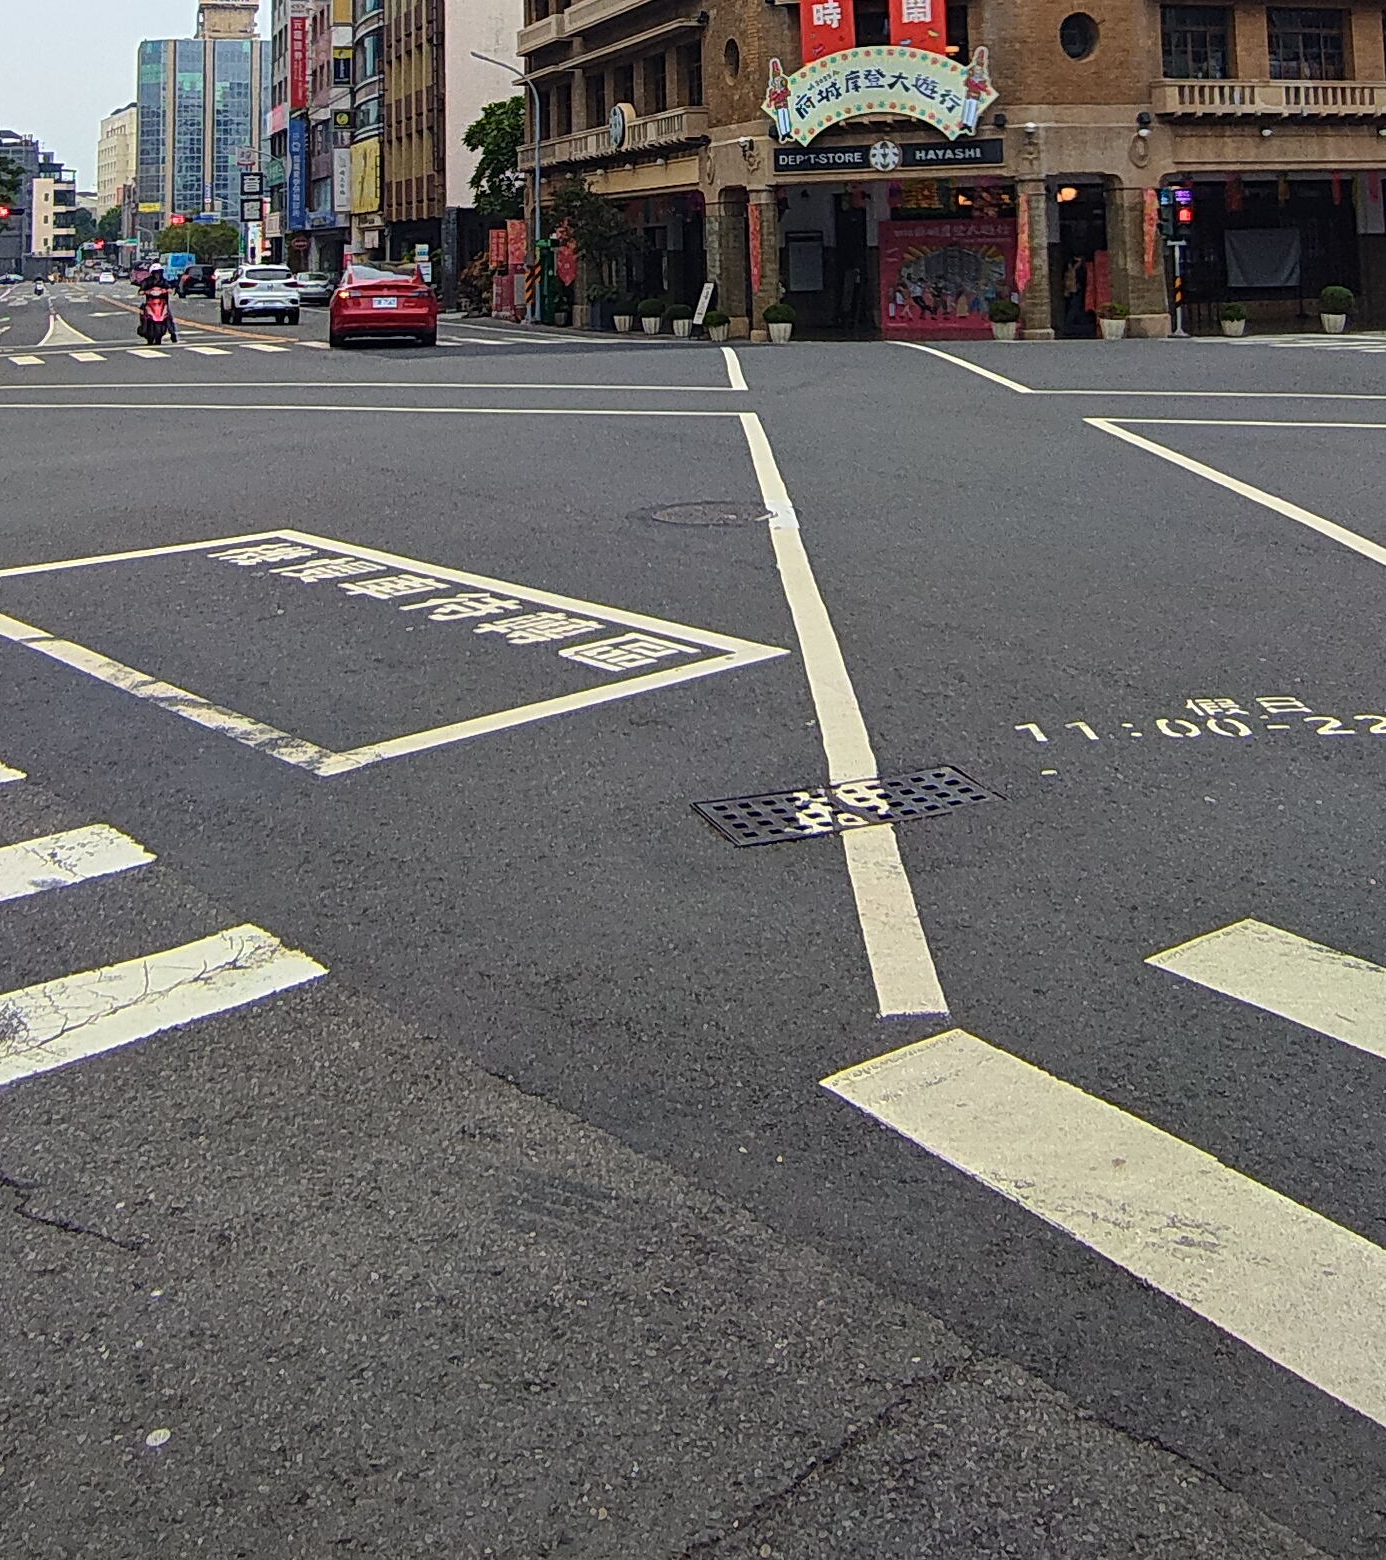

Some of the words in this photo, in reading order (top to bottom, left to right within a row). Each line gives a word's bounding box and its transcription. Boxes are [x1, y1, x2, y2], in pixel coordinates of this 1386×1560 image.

[793, 68, 963, 121] 府城摩登大遊行
[915, 147, 982, 161] HAYASHI
[1183, 694, 1315, 716] 假日
